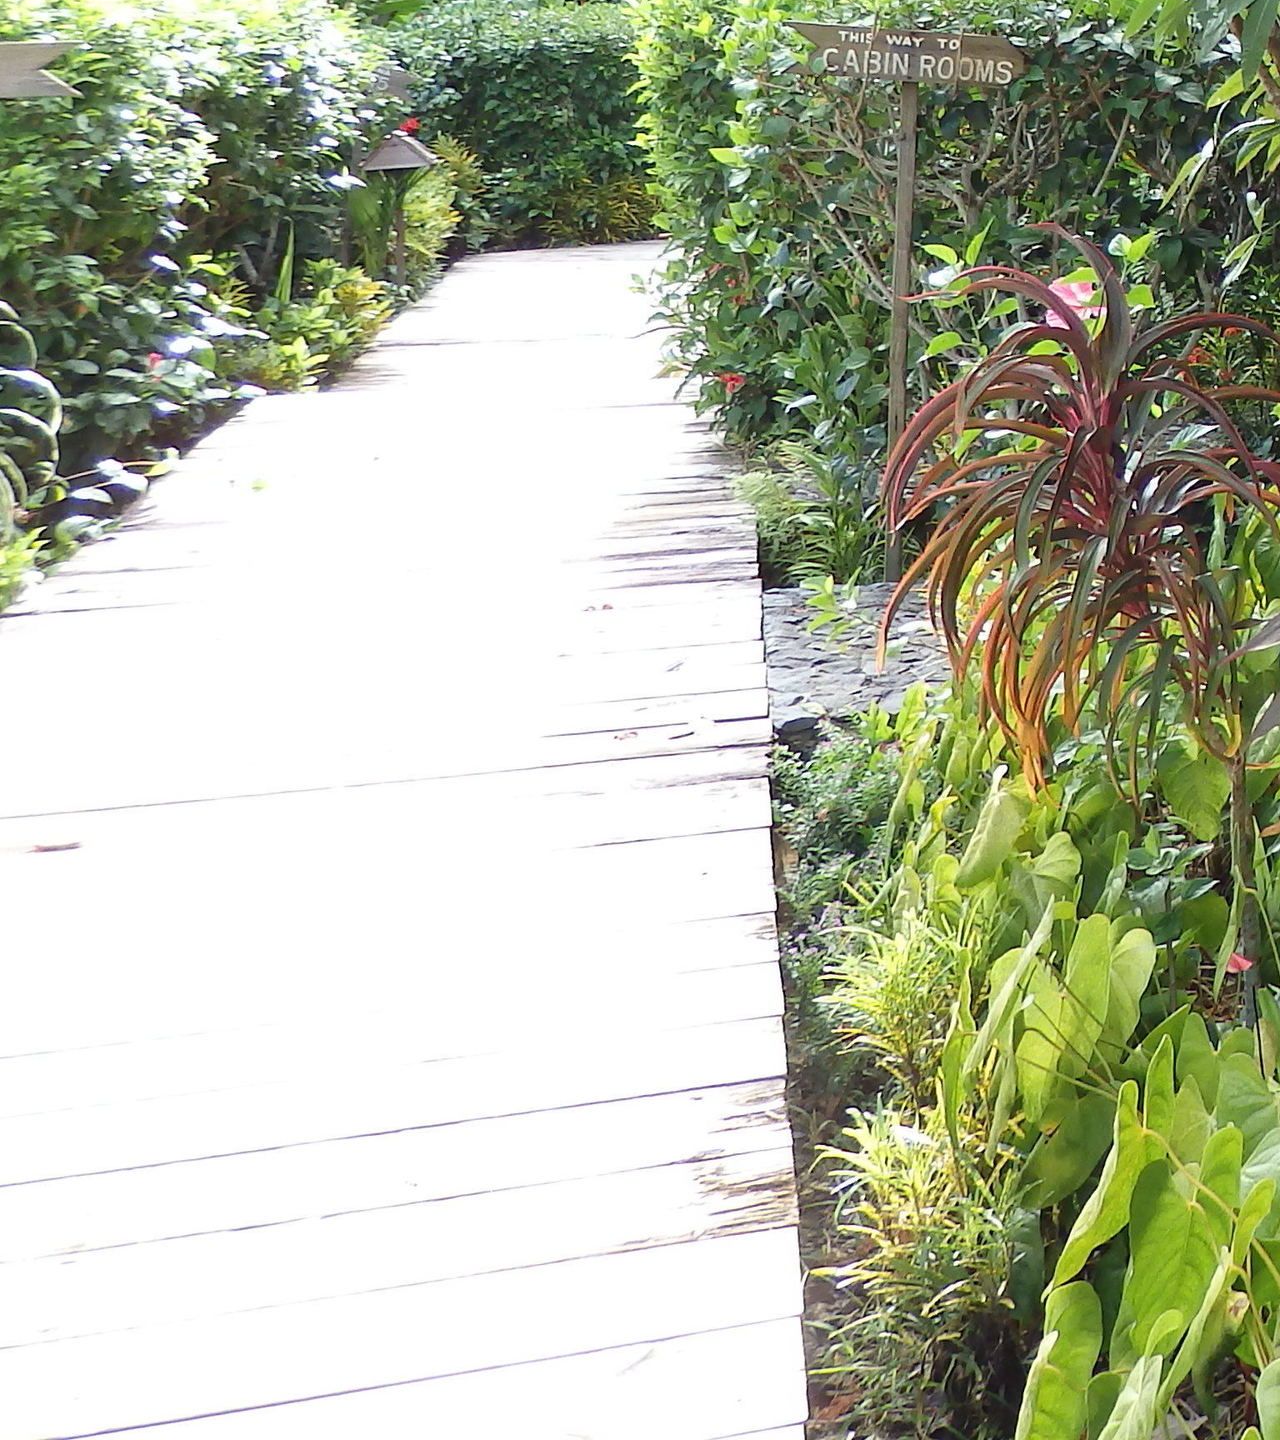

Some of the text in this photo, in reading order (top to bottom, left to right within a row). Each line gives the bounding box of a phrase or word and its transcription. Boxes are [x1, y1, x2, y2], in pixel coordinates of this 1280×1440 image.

[838, 30, 961, 51] THIS WAY TO
[822, 47, 1014, 85] CABIN ROOMS
